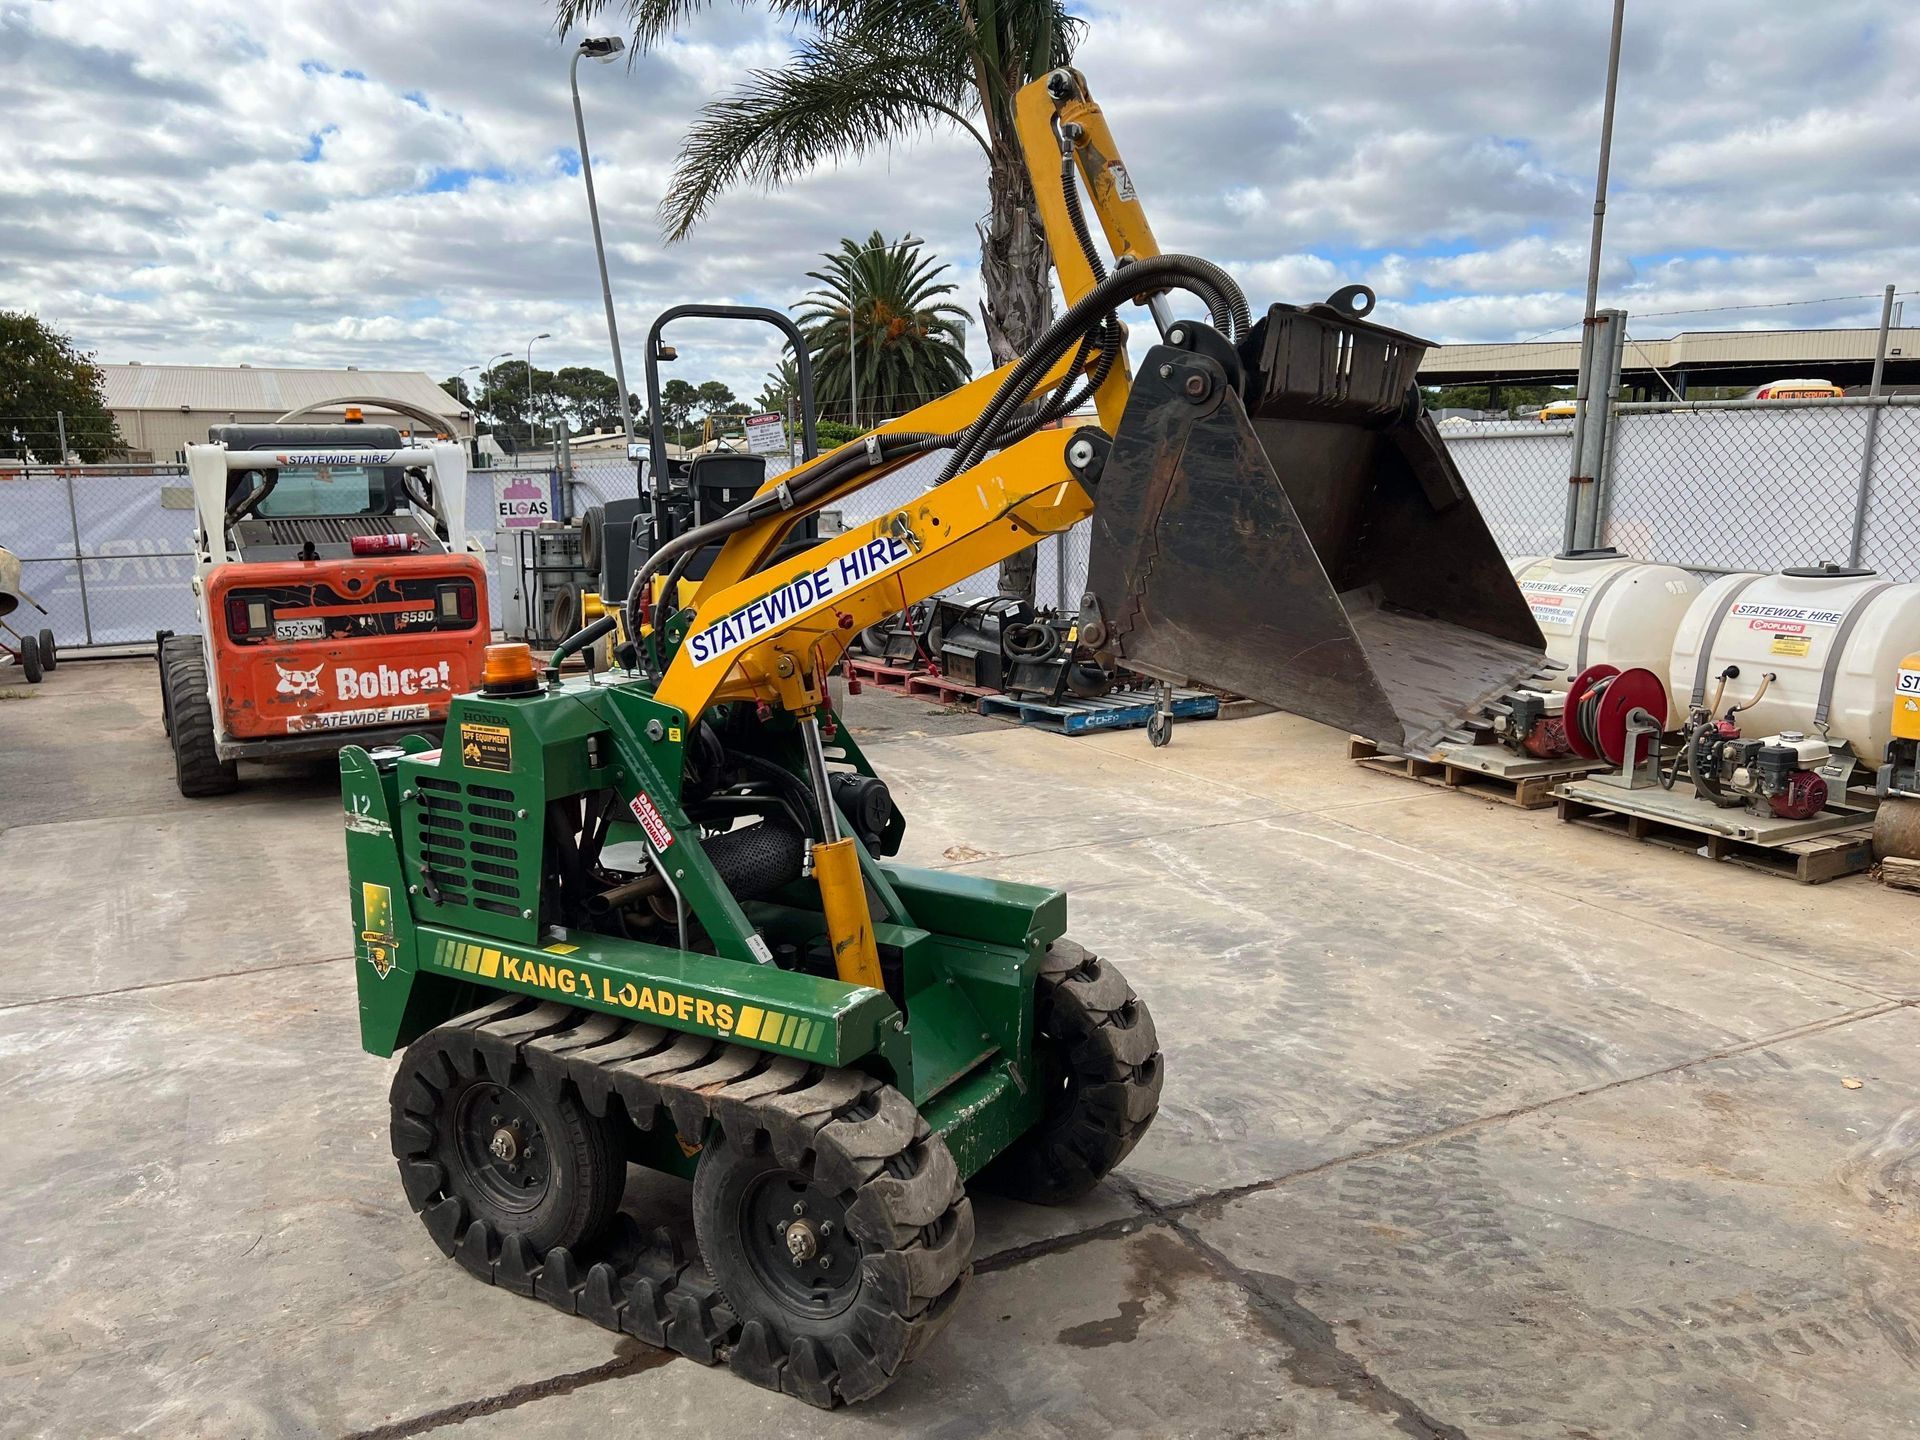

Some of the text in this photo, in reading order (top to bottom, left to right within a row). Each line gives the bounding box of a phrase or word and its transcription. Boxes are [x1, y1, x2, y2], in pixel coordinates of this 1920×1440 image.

[289, 455, 388, 465] STATEWIDE HIRE
[499, 502, 548, 516] ELGAS
[1567, 586, 1591, 594] HIRE
[691, 536, 909, 662] STATEWIDE HIRE
[401, 610, 434, 623] S590
[1738, 605, 1842, 623] STATEWIDE HIRE
[277, 625, 299, 637] S52
[1752, 619, 1802, 632] CROPLANDS
[335, 660, 451, 701] Bobcat
[1901, 674, 1920, 690] ST
[391, 708, 426, 721] HIRE
[463, 712, 510, 726] HONDA
[475, 733, 508, 744] EQUIPMENT
[631, 801, 666, 849] HOT EXHAUST
[638, 793, 672, 844] DANGER
[603, 977, 734, 1031] LOADERS
